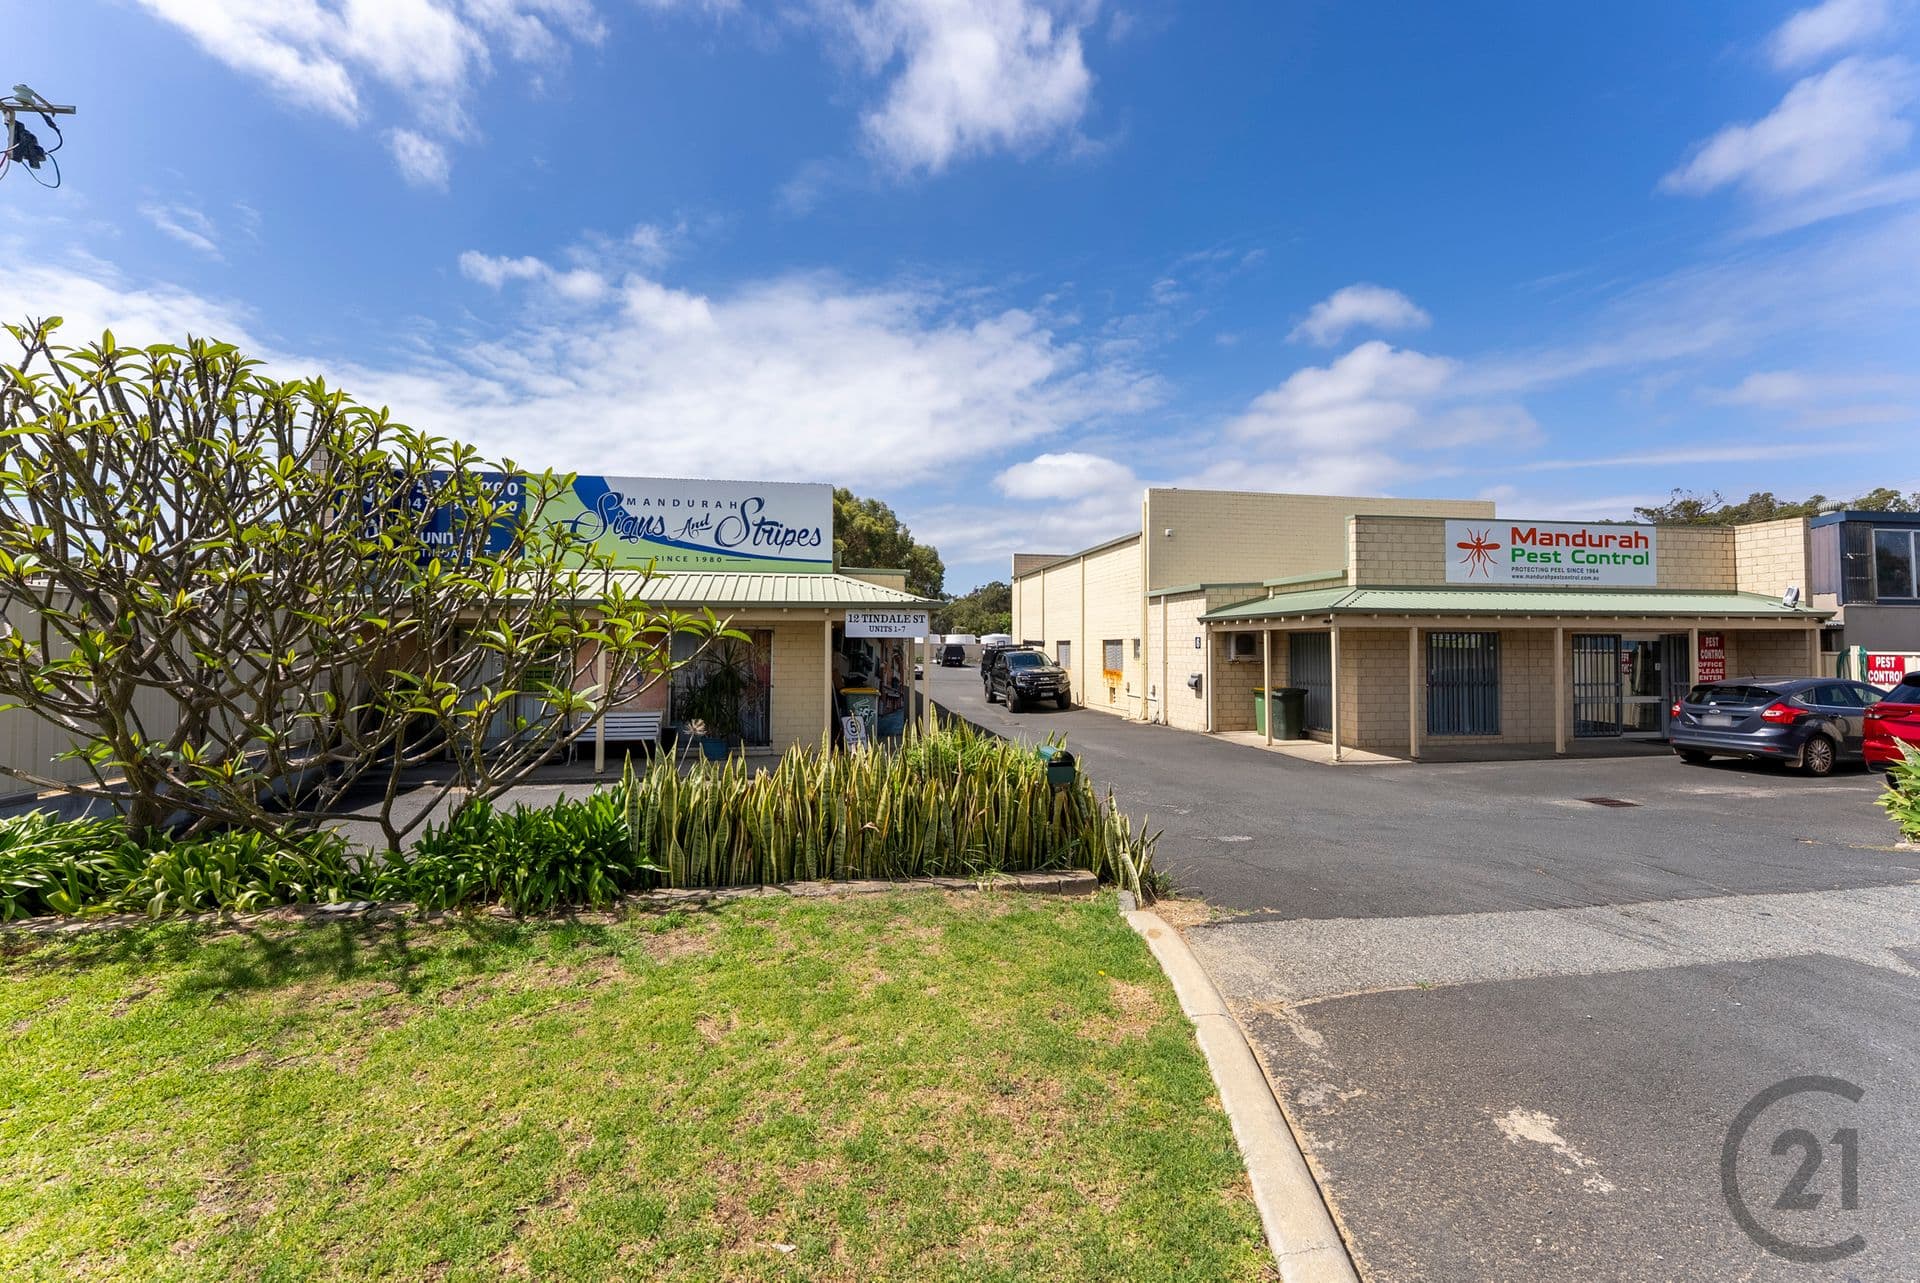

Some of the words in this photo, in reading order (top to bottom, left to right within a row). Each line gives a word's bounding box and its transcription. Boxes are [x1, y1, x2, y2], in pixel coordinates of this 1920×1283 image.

[626, 498, 737, 509] MANDURAH
[666, 513, 713, 541] And
[714, 497, 822, 555] Stripes
[420, 532, 453, 544] UNIT
[1511, 527, 1649, 549] Mandurah
[1511, 548, 1562, 564] Pest
[1571, 549, 1649, 566] Control
[848, 614, 859, 623] 12
[862, 614, 911, 624] TINDALE
[913, 614, 925, 624] ST
[869, 625, 892, 633] UNITS
[894, 625, 906, 633] 1-7
[1705, 637, 1719, 647] PEST
[1700, 649, 1724, 659] CONTROL
[1875, 656, 1896, 668] PEST
[850, 721, 858, 734] 5
